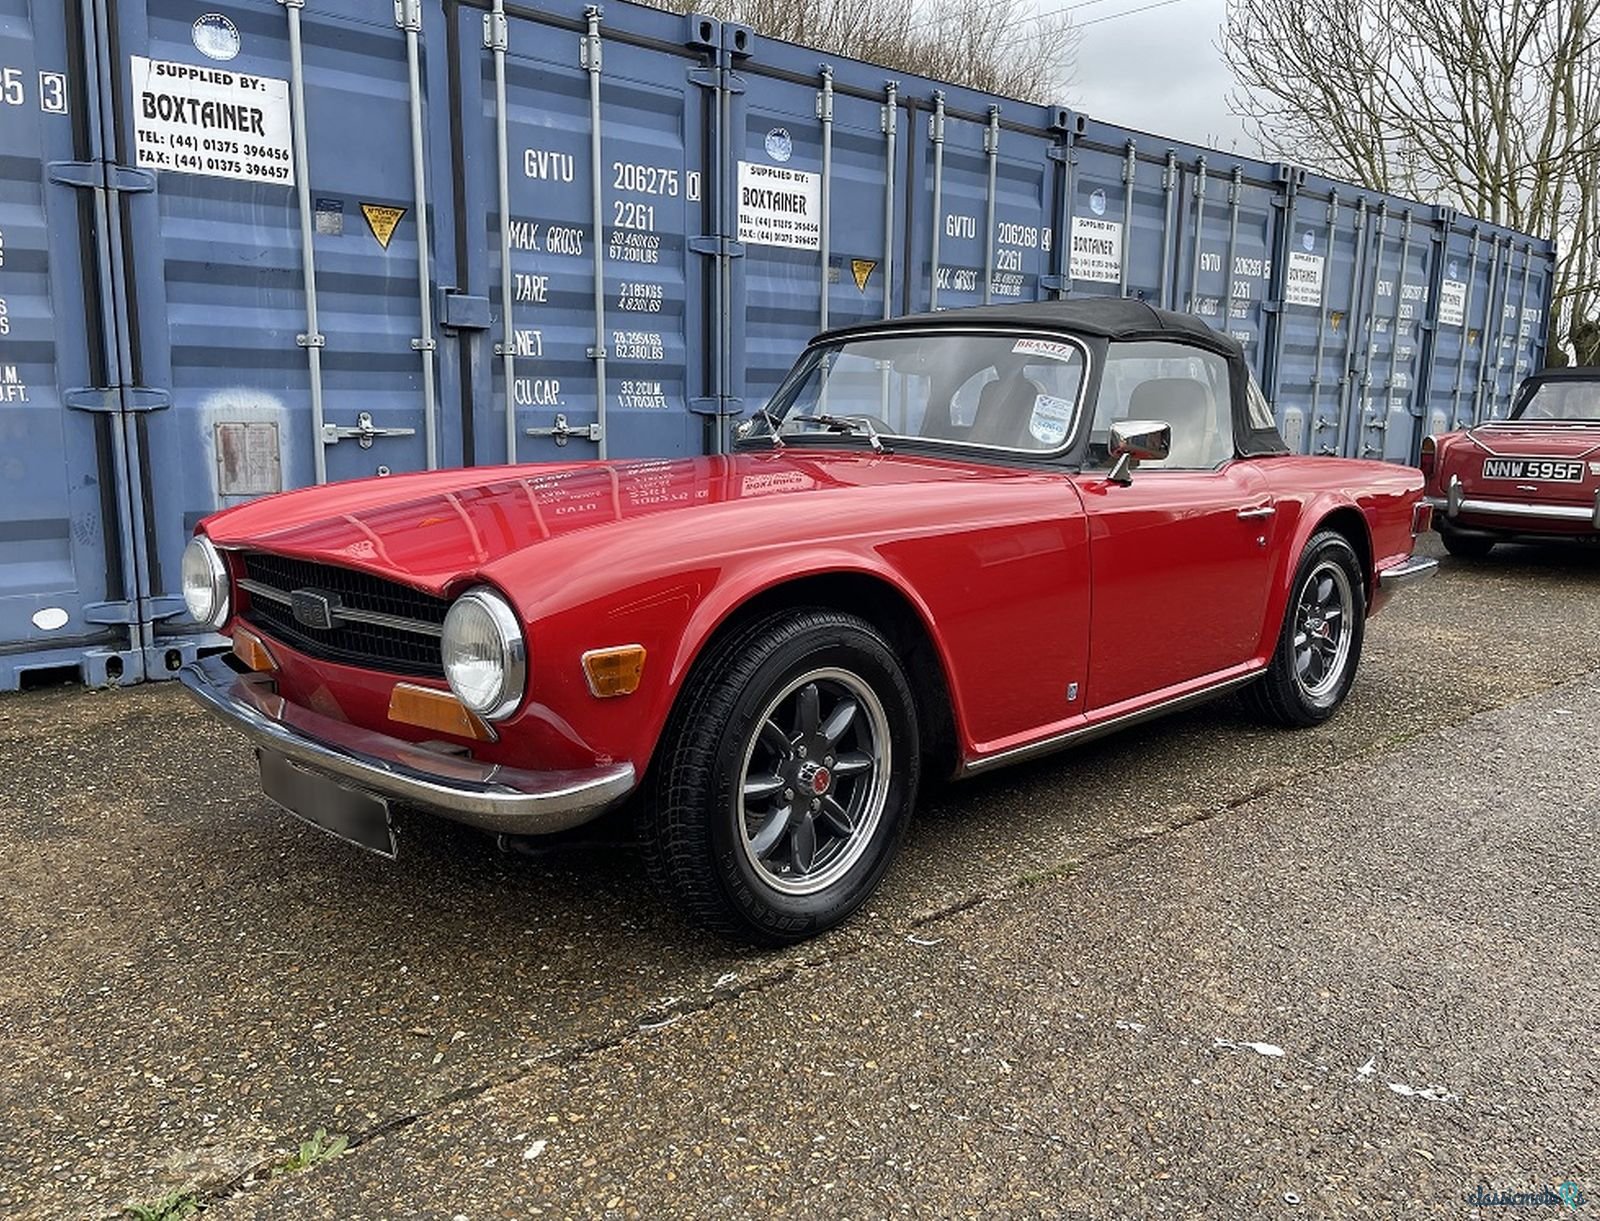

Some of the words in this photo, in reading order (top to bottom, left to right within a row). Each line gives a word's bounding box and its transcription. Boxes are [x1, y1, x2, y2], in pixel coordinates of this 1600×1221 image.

[0, 68, 24, 105] 5
[42, 74, 65, 111] 3
[156, 64, 233, 85] SUPPLIED
[240, 77, 266, 91] BY:
[142, 92, 265, 137] BOXTAINER
[138, 130, 165, 144] TEL:
[170, 134, 198, 151] (44)
[203, 139, 239, 154] 01375
[243, 144, 289, 161] 396456
[139, 150, 170, 164] FAX:
[175, 154, 202, 169] (44)
[207, 159, 241, 173] 01375
[246, 164, 289, 179] 396457
[524, 148, 574, 182] GVTU
[613, 162, 678, 196] 206275
[750, 166, 792, 180] SUPPLIED
[614, 200, 653, 232] 22G1
[742, 187, 807, 216] BOXTAINER
[508, 221, 540, 251] MAX.
[547, 226, 583, 255] GROSS
[946, 214, 976, 238] GVTU
[998, 222, 1037, 248] 206268
[515, 274, 548, 302] TARE
[514, 330, 542, 356] NET
[1018, 340, 1067, 353] BRANTZ
[514, 380, 565, 405] CU.CAP.
[1485, 461, 1523, 477] NNW
[1527, 462, 1581, 479] 595F
